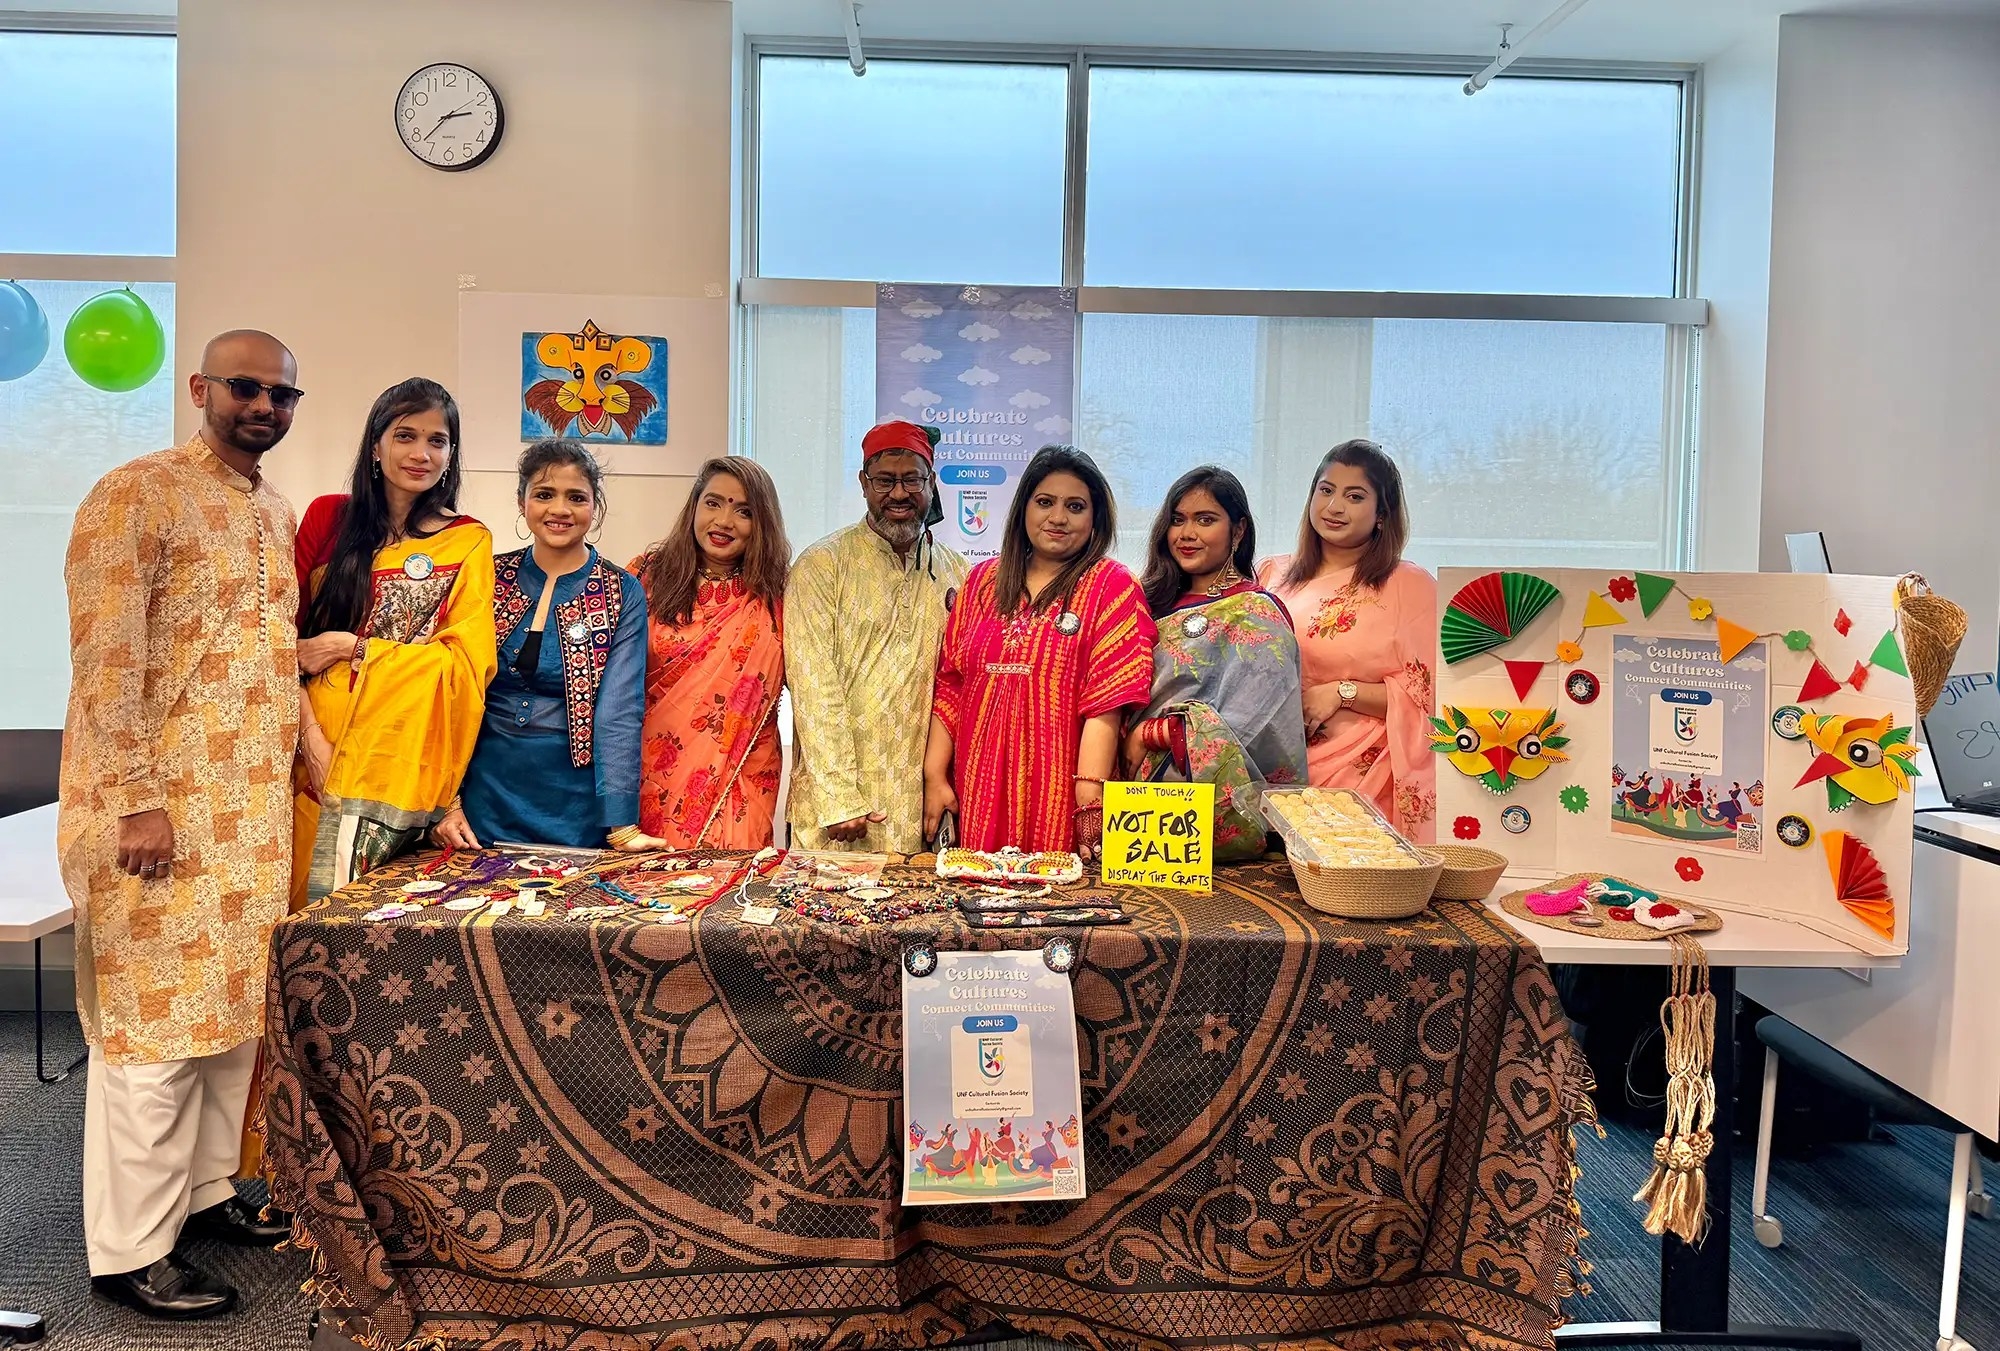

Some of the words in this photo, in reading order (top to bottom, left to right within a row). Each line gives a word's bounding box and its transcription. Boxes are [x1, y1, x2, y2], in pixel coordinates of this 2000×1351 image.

[427, 78, 437, 92] 11
[442, 72, 456, 87] 12
[466, 78, 470, 92] 1
[412, 92, 428, 106] 10
[476, 92, 487, 106] 2
[404, 108, 415, 123] 9
[484, 110, 493, 126] 3
[411, 127, 421, 142] 8
[475, 129, 486, 144] 4
[426, 141, 436, 156] 7
[443, 146, 454, 161] 6
[462, 143, 473, 158] 5
[921, 406, 1028, 425] Celebrate
[941, 429, 1025, 446] ultures
[956, 470, 977, 478] JOIN
[978, 470, 990, 478] US
[1649, 661, 1725, 678] Cultures
[1624, 673, 1670, 685] Connect
[1672, 677, 1752, 691] Communities
[1673, 691, 1689, 700] JOIN
[1689, 693, 1699, 701] US
[1700, 752, 1718, 760] Society
[1107, 810, 1154, 833] NOT
[1159, 809, 1200, 838] FOR
[1126, 838, 1201, 864] SALE
[1108, 868, 1146, 883] DISPLAY
[1149, 871, 1167, 883] THE
[945, 965, 1030, 982] Celebrate
[949, 985, 1028, 1000] Cultures
[921, 1004, 972, 1014] Connect
[975, 1002, 1056, 1013] Communities
[976, 1019, 993, 1028] JOIN
[994, 1018, 1004, 1027] US
[1009, 1089, 1029, 1097] Society
